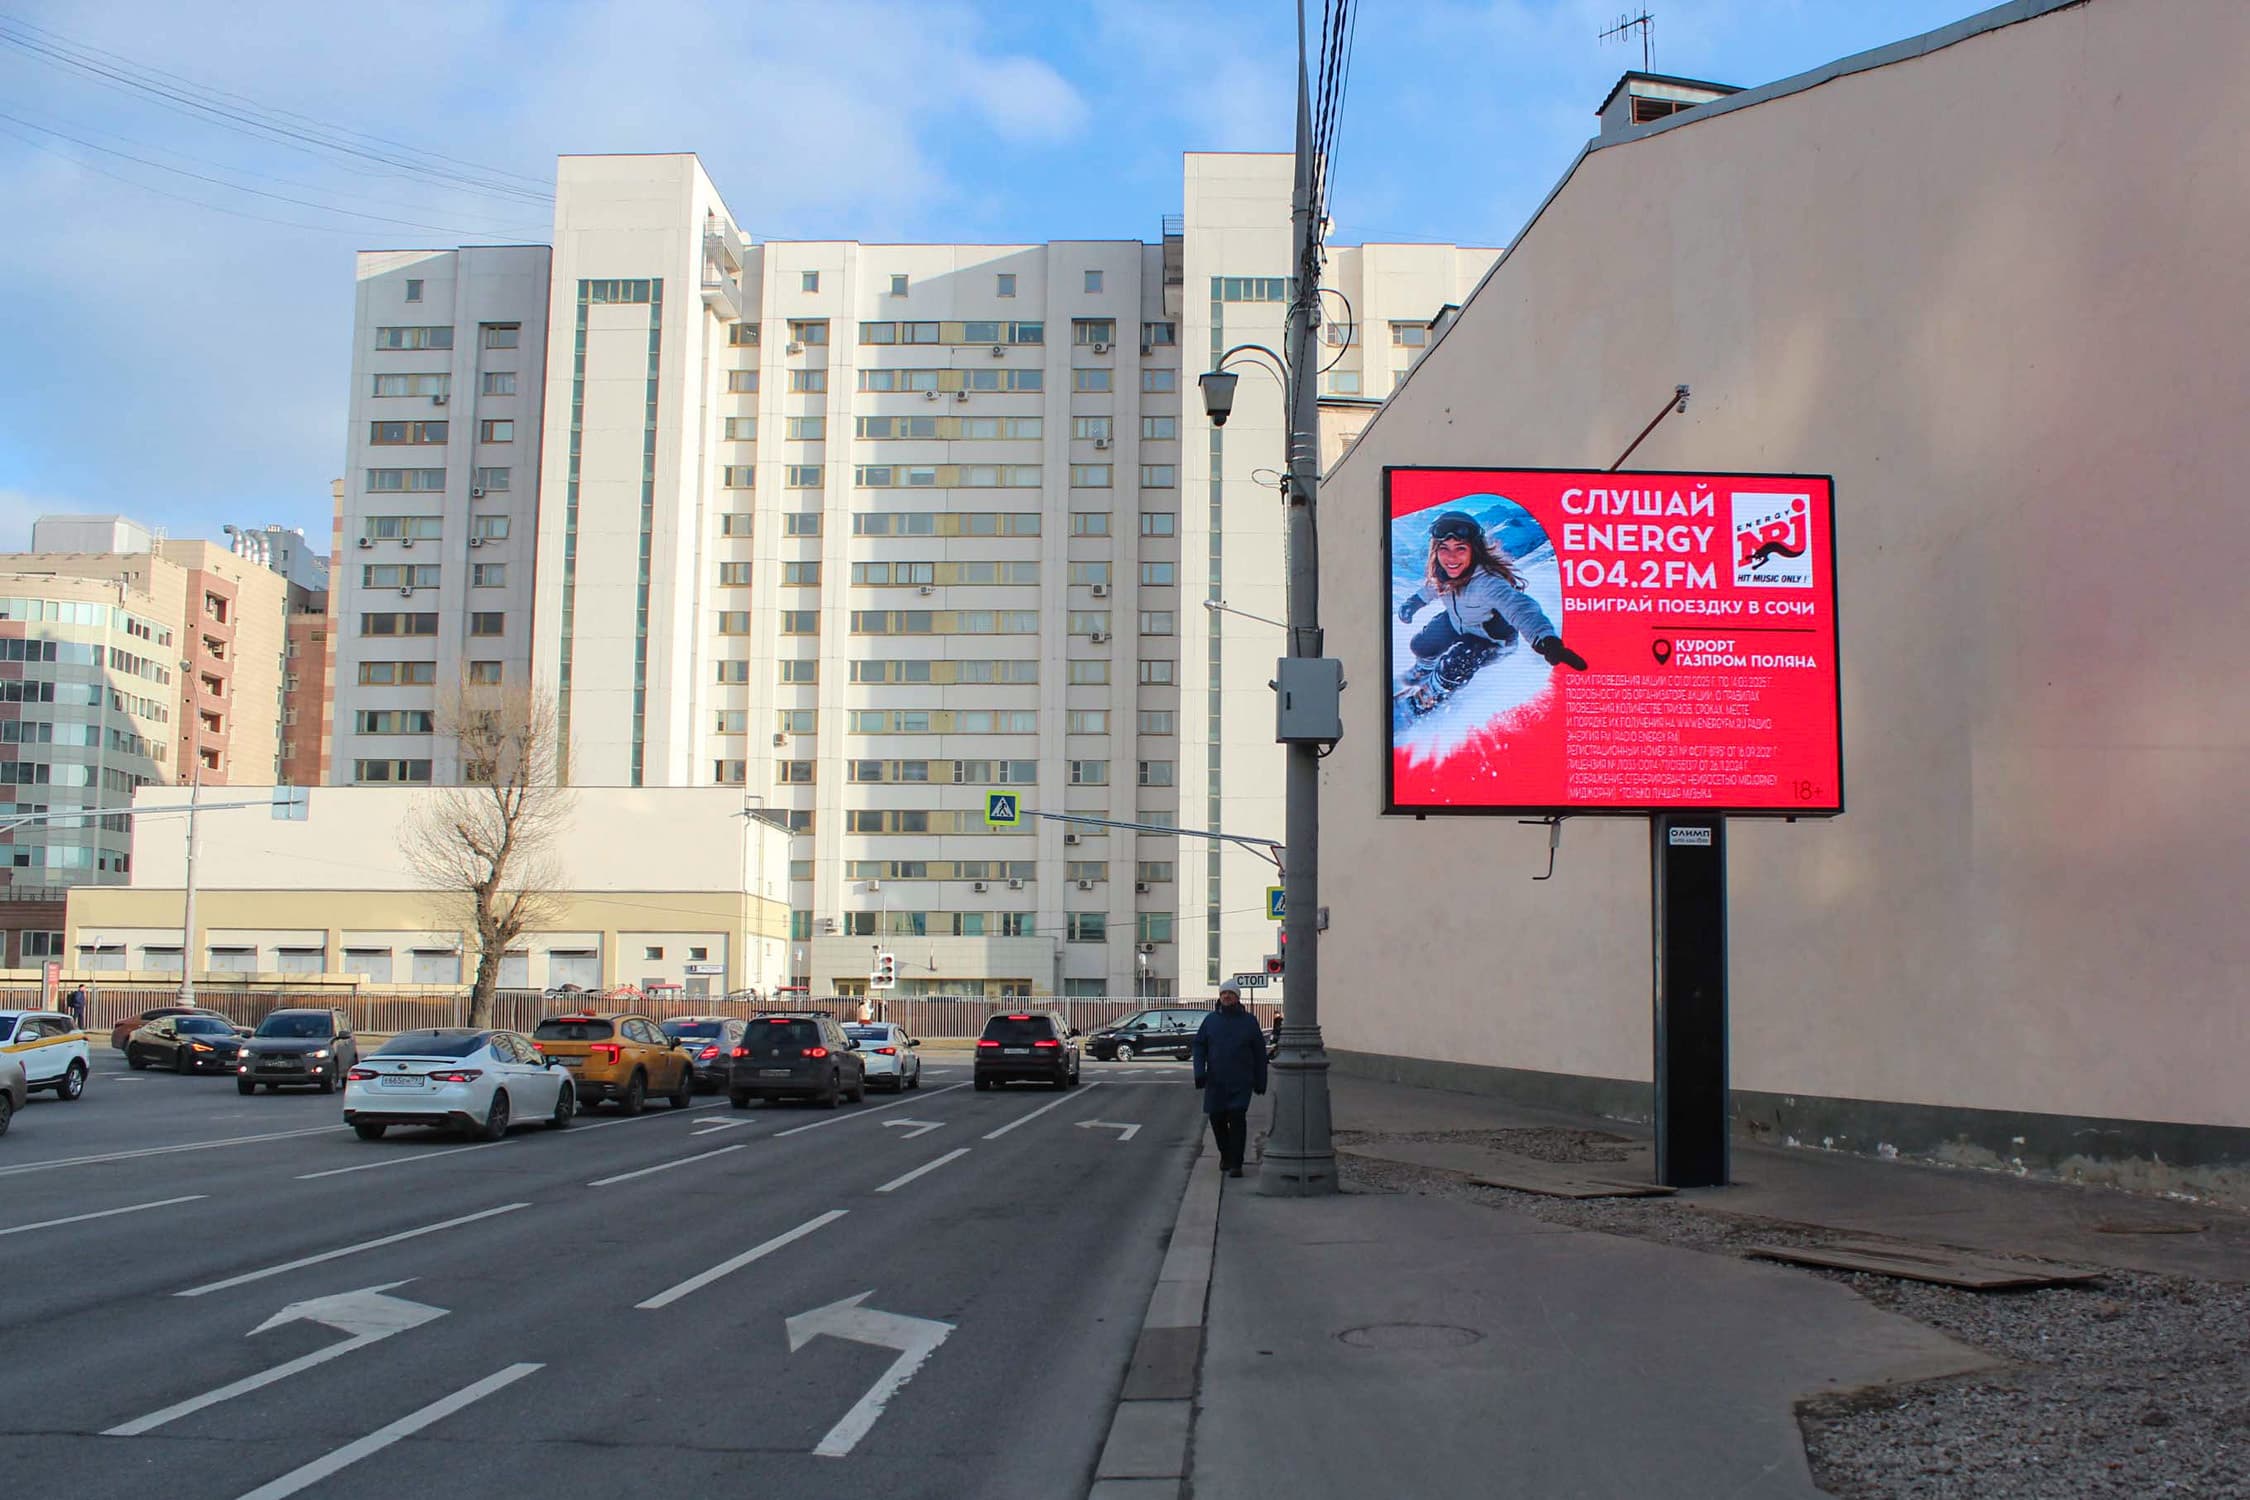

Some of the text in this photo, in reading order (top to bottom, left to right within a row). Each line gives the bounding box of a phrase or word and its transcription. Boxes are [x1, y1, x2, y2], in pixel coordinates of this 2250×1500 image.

[1561, 483, 1715, 517] СЛУШАЙ
[1737, 509, 1791, 532] ENERGY
[1563, 523, 1714, 553] ENERGY
[1563, 559, 1717, 590] 104.2FM
[1737, 574, 1751, 583] HIT
[1753, 574, 1780, 583] MUSIC
[1565, 595, 1815, 616] ВЫИГРАЙ ПОЕЗДКУ В СОЧИ
[1675, 639, 1736, 653] КУРОРТ
[1675, 653, 1817, 669] ГАЗПРОМ ПОЛЯНА
[1792, 780, 1823, 801] 18+
[1670, 830, 1710, 838] ОЛИМП
[1237, 975, 1264, 986] СТОП
